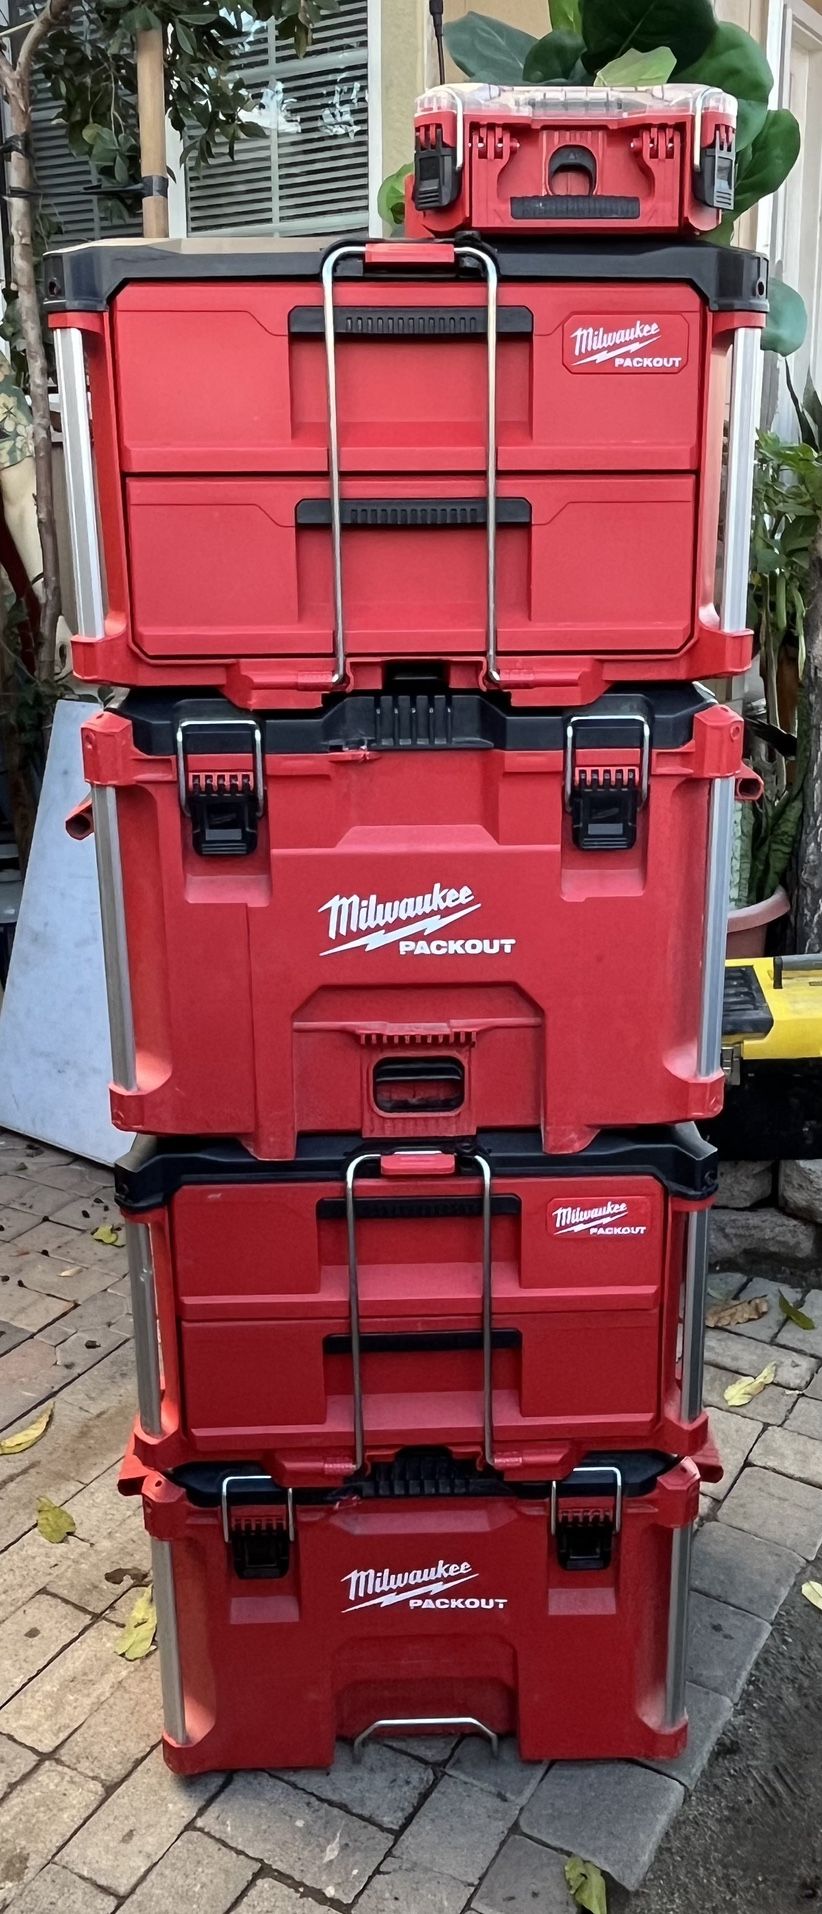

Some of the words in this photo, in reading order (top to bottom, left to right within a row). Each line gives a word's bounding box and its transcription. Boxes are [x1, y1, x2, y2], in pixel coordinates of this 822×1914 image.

[570, 320, 660, 356] Milwaukee
[614, 357, 682, 368] PACKOUT
[317, 882, 475, 940] Milwaukee
[399, 938, 516, 956] PACKOUT
[551, 1201, 628, 1228] Milwaukee
[589, 1226, 647, 1235] PACKOUT
[340, 1559, 473, 1601] Milwaukee
[408, 1598, 508, 1610] PACKOUT
